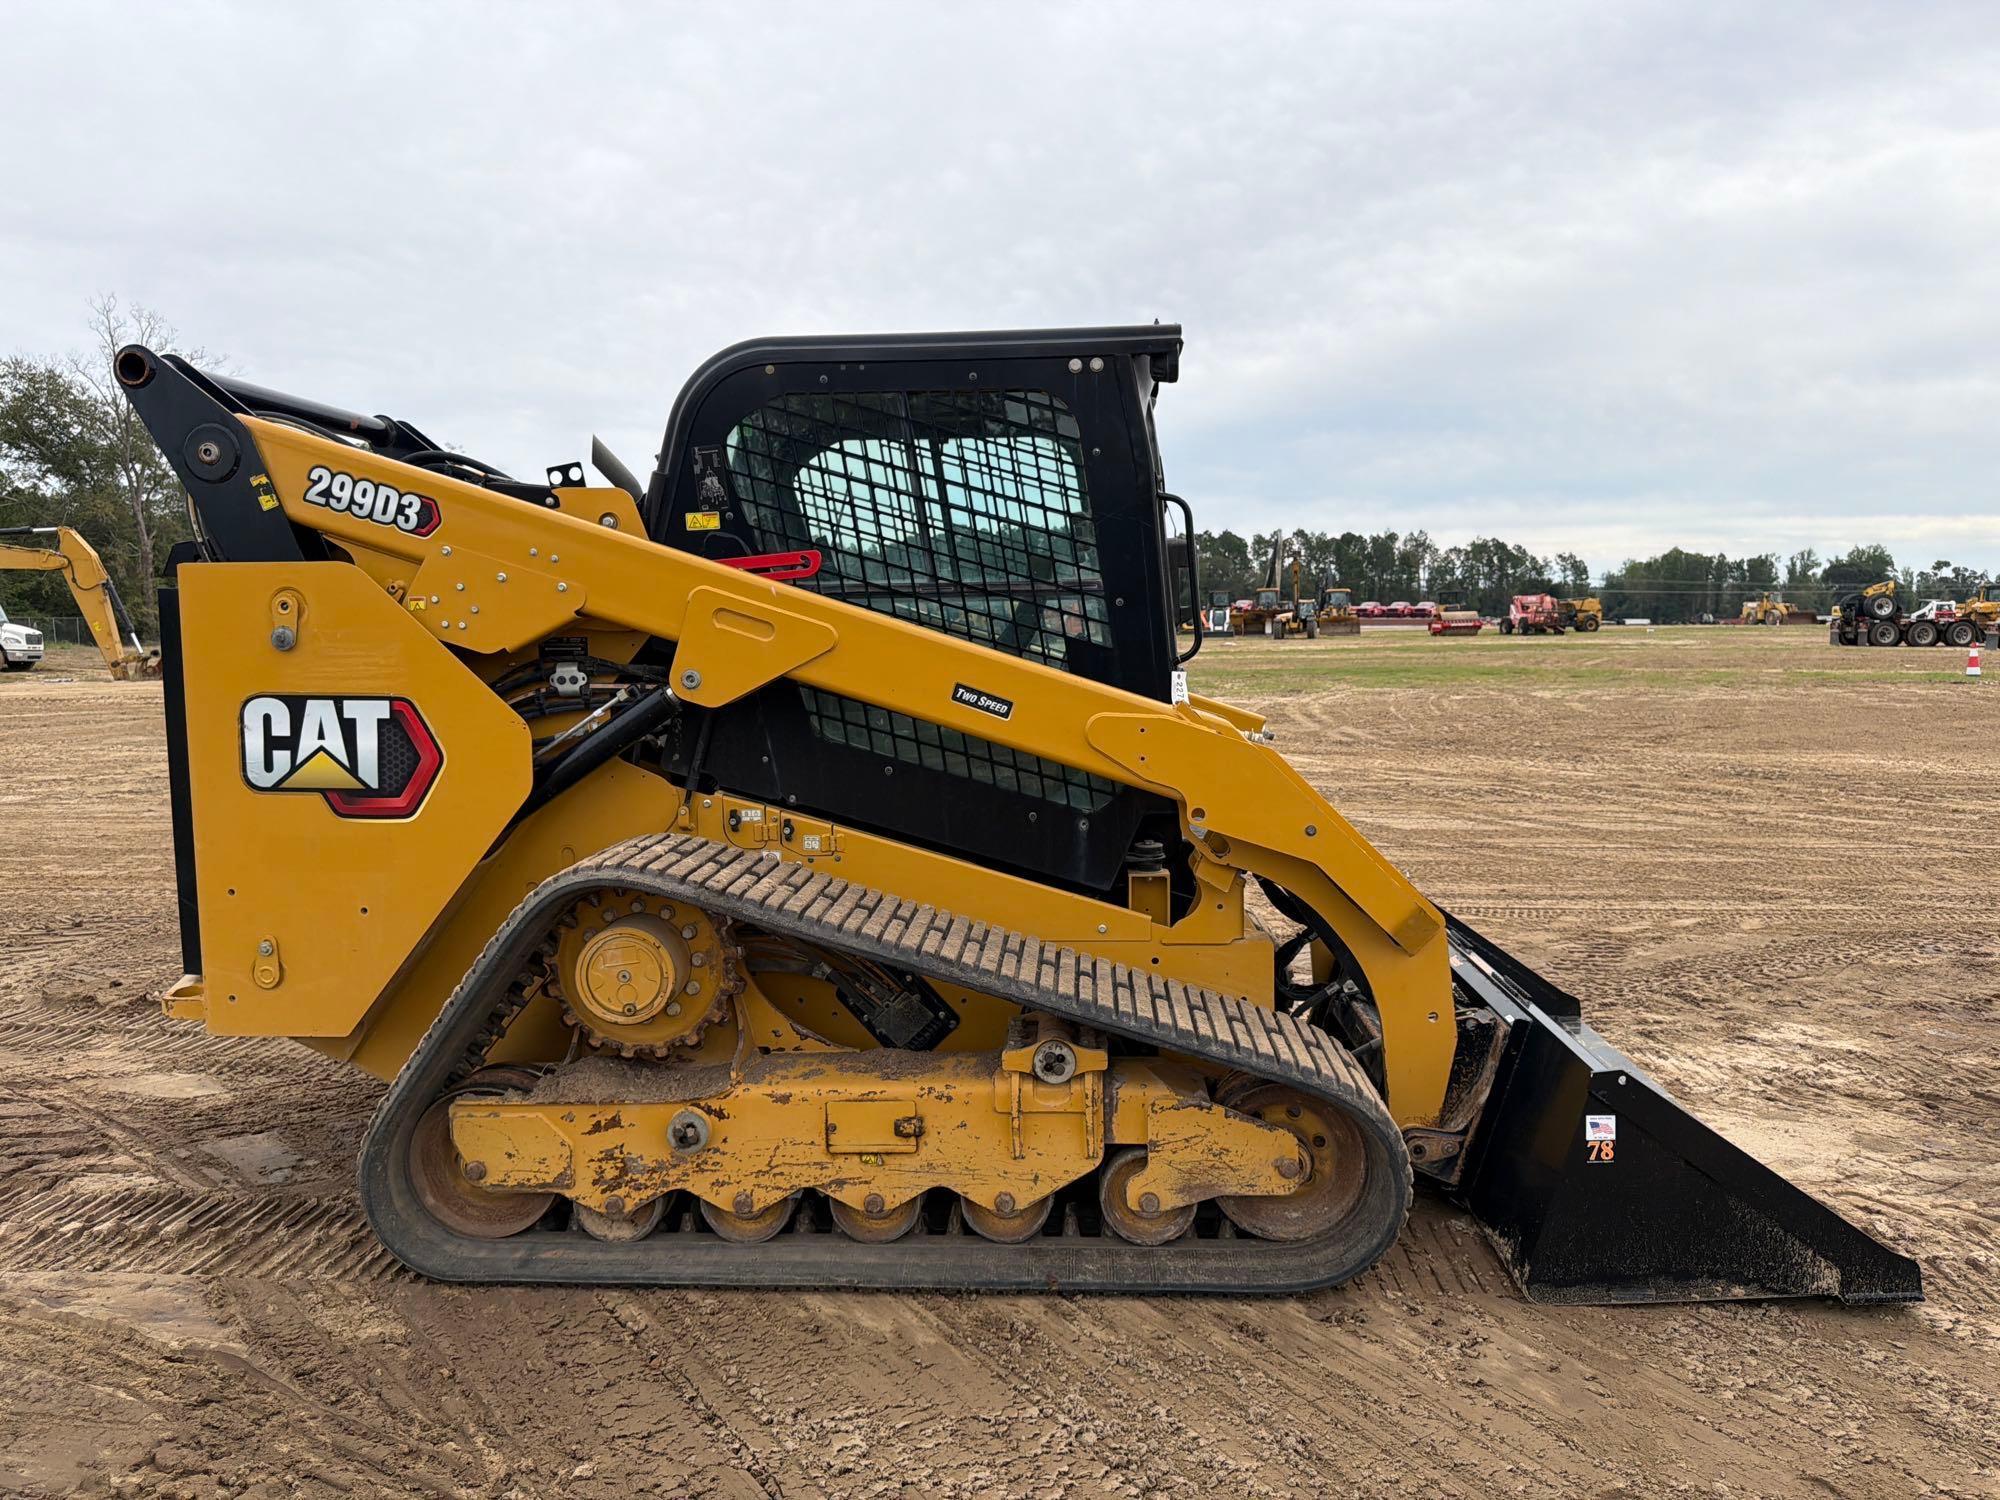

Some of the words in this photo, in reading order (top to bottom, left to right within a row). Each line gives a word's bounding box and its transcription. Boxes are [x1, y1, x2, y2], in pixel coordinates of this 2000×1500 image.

[304, 466, 422, 531] 299D3
[956, 688, 978, 703] TWO
[977, 696, 1009, 714] SPEED
[243, 696, 391, 790] CAT
[1586, 1140, 1614, 1161] 78
